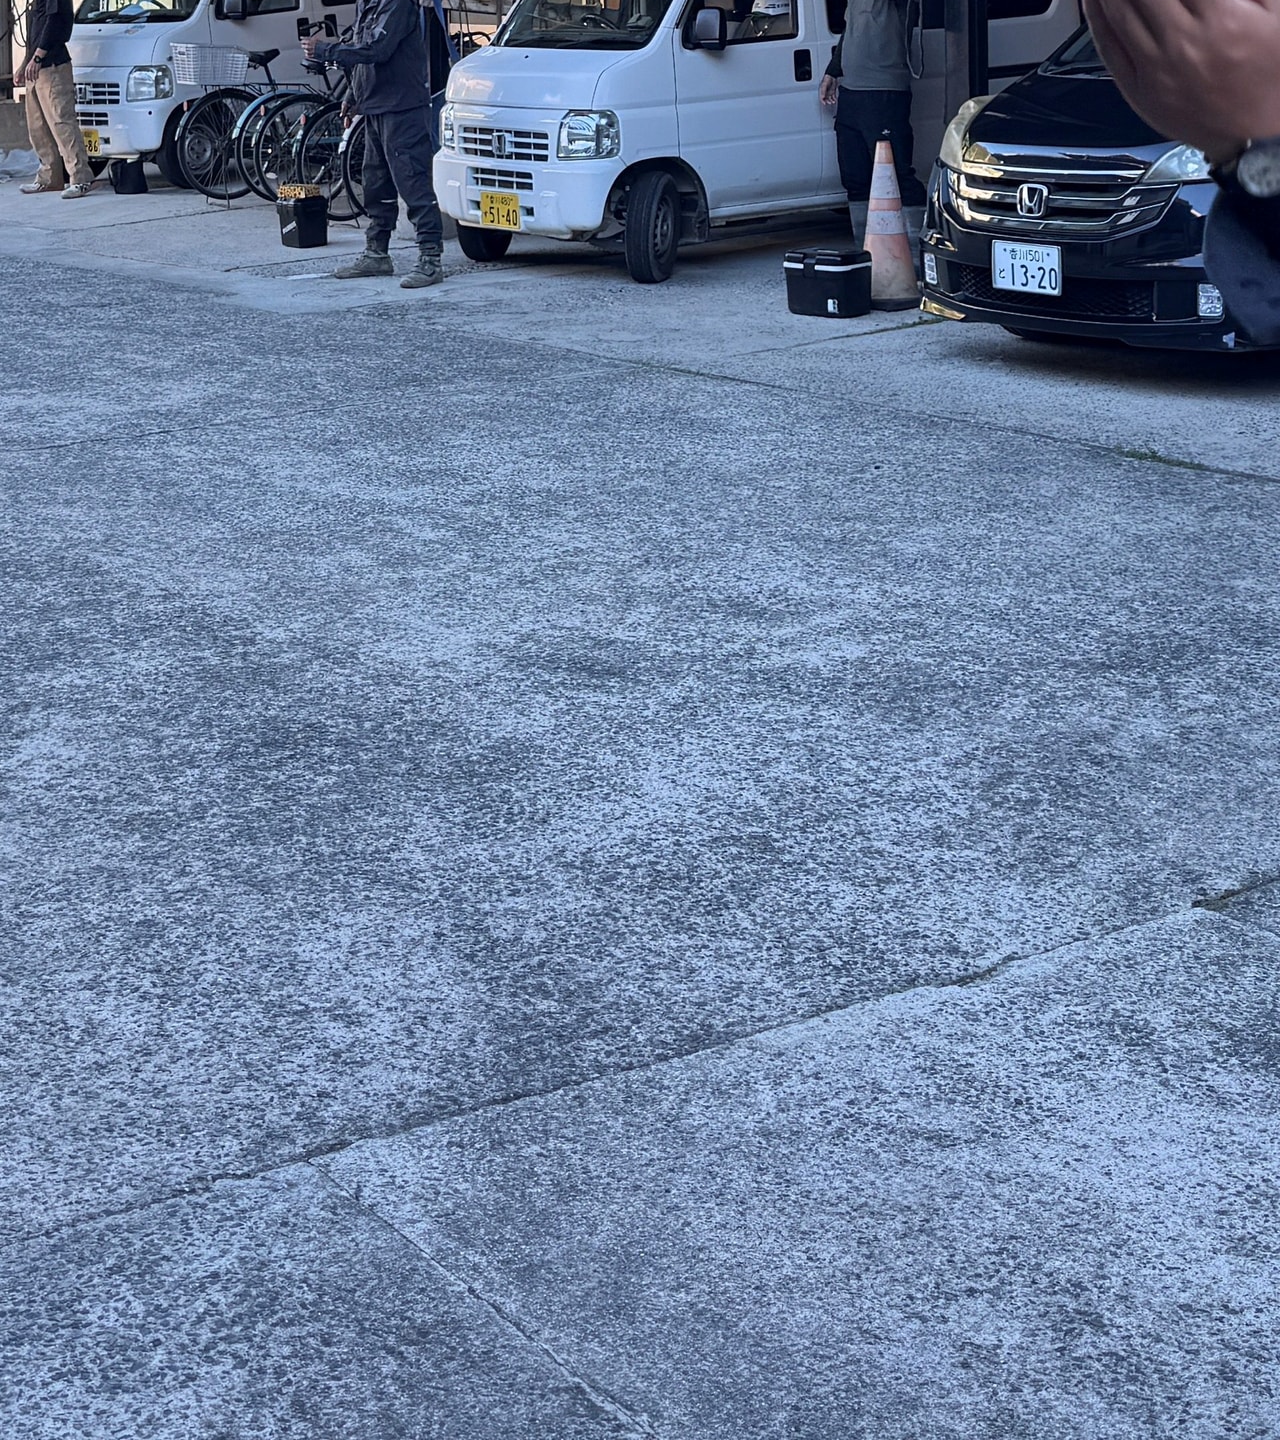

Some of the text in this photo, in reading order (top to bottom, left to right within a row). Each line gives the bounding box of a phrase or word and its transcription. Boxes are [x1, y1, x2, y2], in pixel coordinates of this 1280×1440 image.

[1009, 247, 1045, 263] 香川501
[998, 263, 1058, 291] と 13-20
